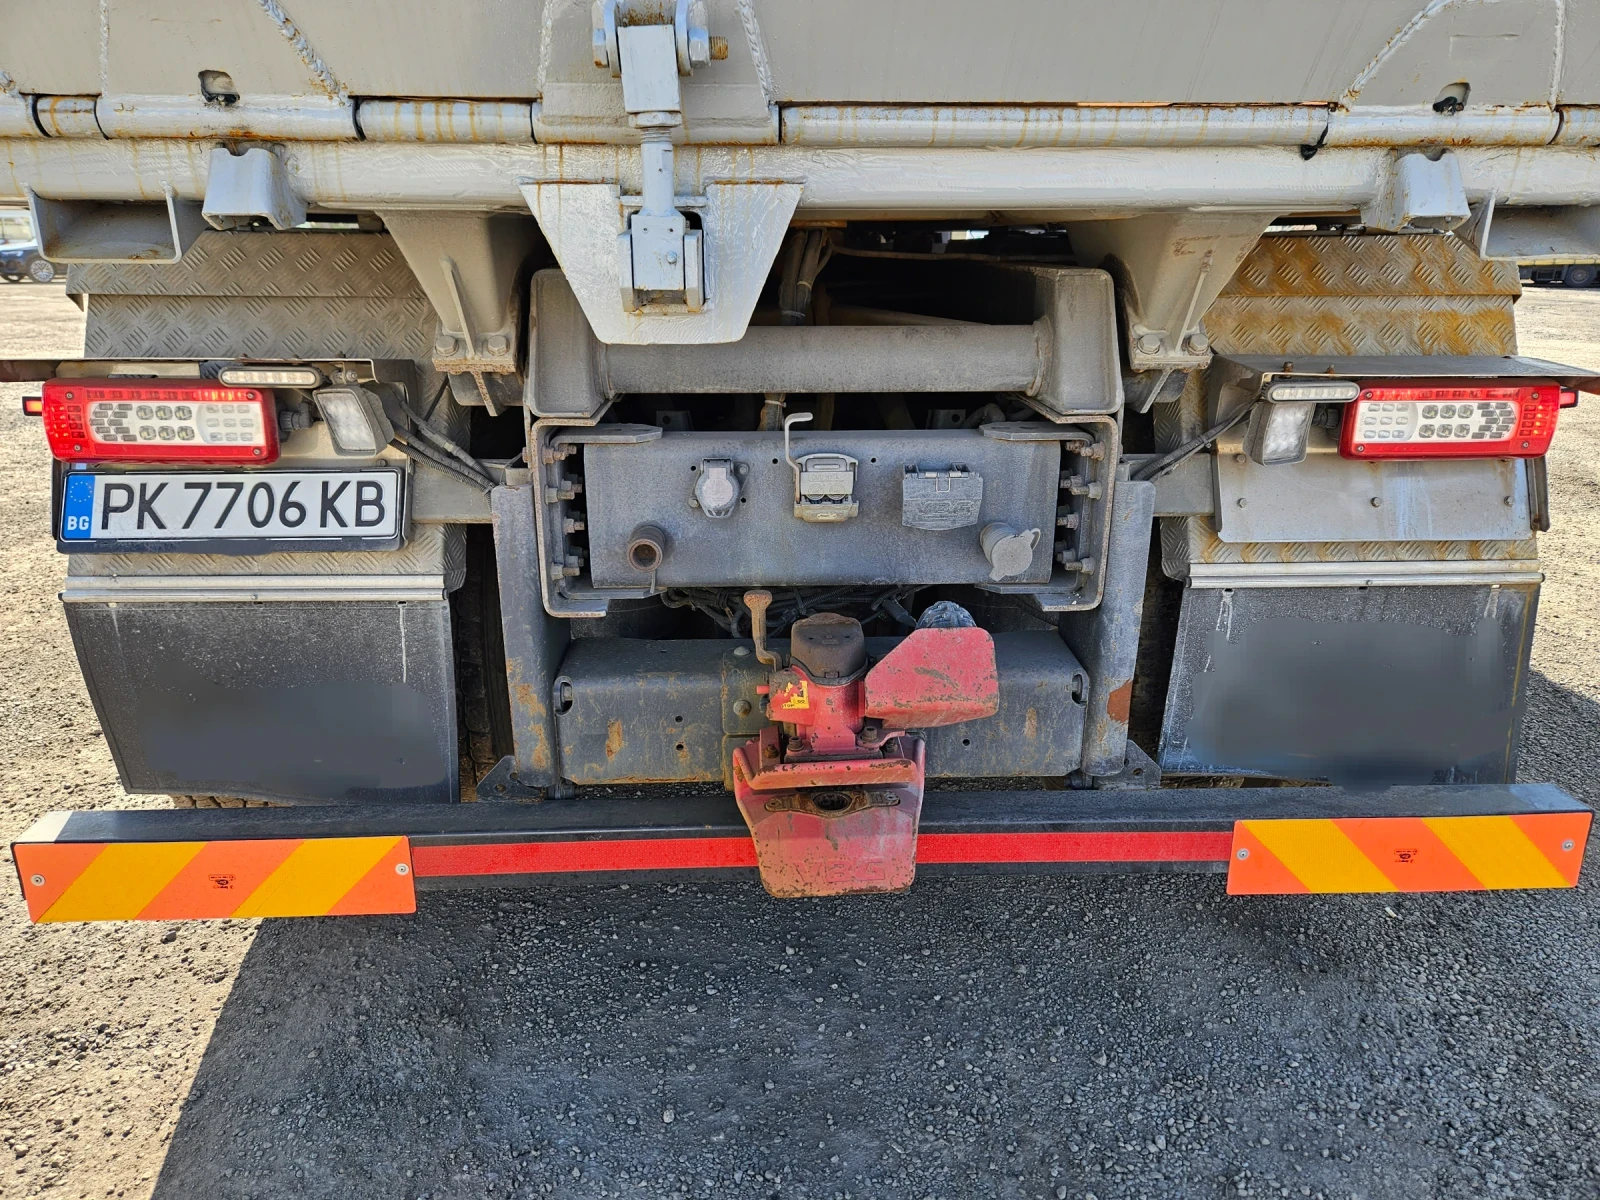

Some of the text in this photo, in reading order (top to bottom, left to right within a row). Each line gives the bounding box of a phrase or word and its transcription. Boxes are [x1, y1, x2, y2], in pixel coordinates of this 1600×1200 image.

[101, 480, 386, 530] PK 7706 KB
[67, 516, 90, 531] BG
[793, 856, 886, 884] VBG
